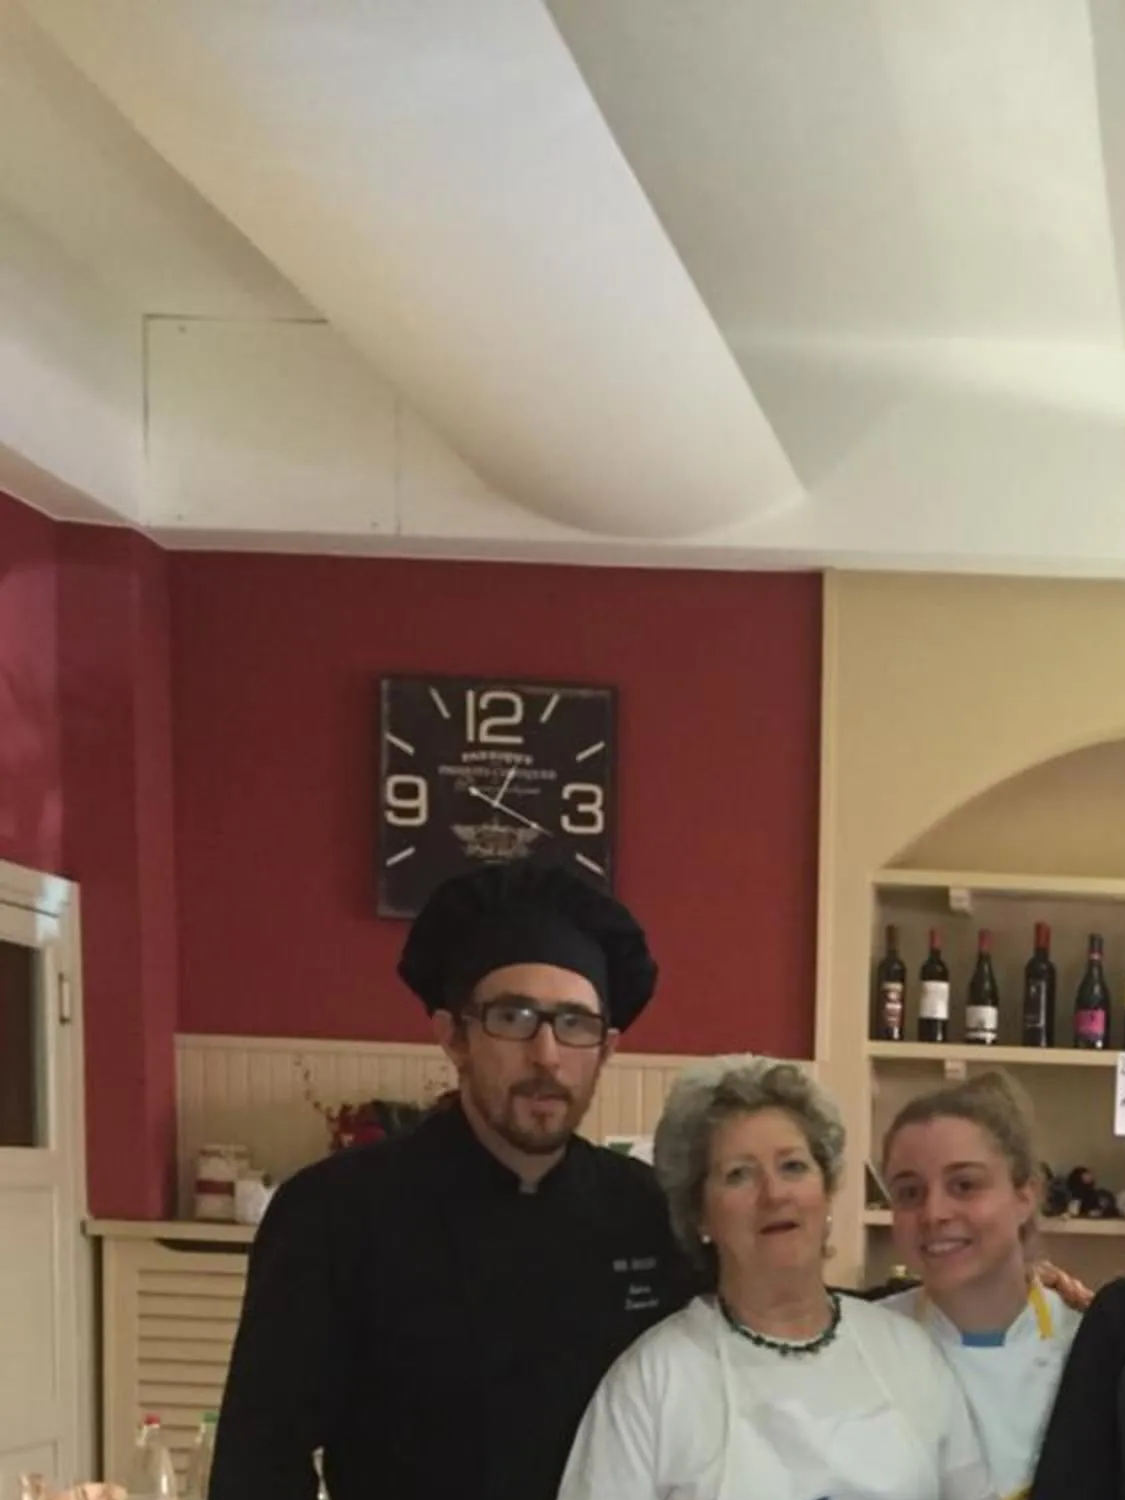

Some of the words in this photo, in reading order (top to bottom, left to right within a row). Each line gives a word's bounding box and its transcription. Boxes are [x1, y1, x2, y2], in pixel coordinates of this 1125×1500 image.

[465, 690, 524, 744] 12
[385, 774, 429, 827] 9
[560, 783, 604, 835] 3
